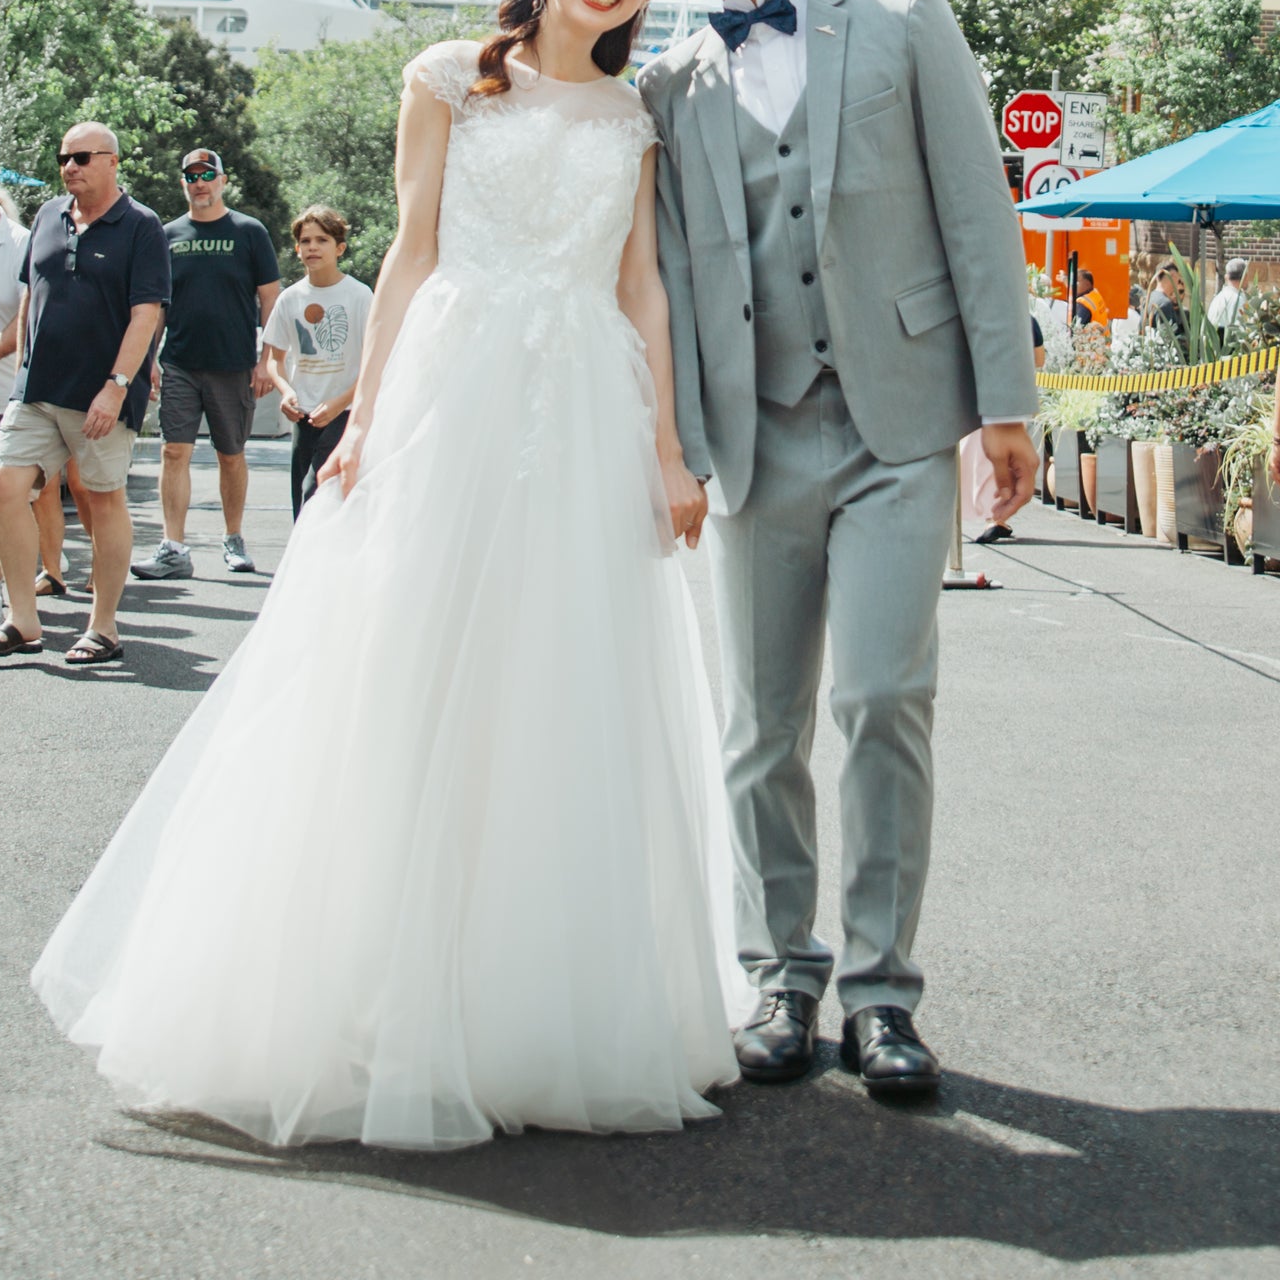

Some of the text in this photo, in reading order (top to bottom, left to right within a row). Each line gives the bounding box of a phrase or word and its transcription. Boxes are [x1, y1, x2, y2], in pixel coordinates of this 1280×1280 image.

[1007, 110, 1059, 134] STOP
[1068, 120, 1101, 129] SHARED
[1073, 131, 1095, 140] ZONE
[192, 239, 235, 252] KUIU
